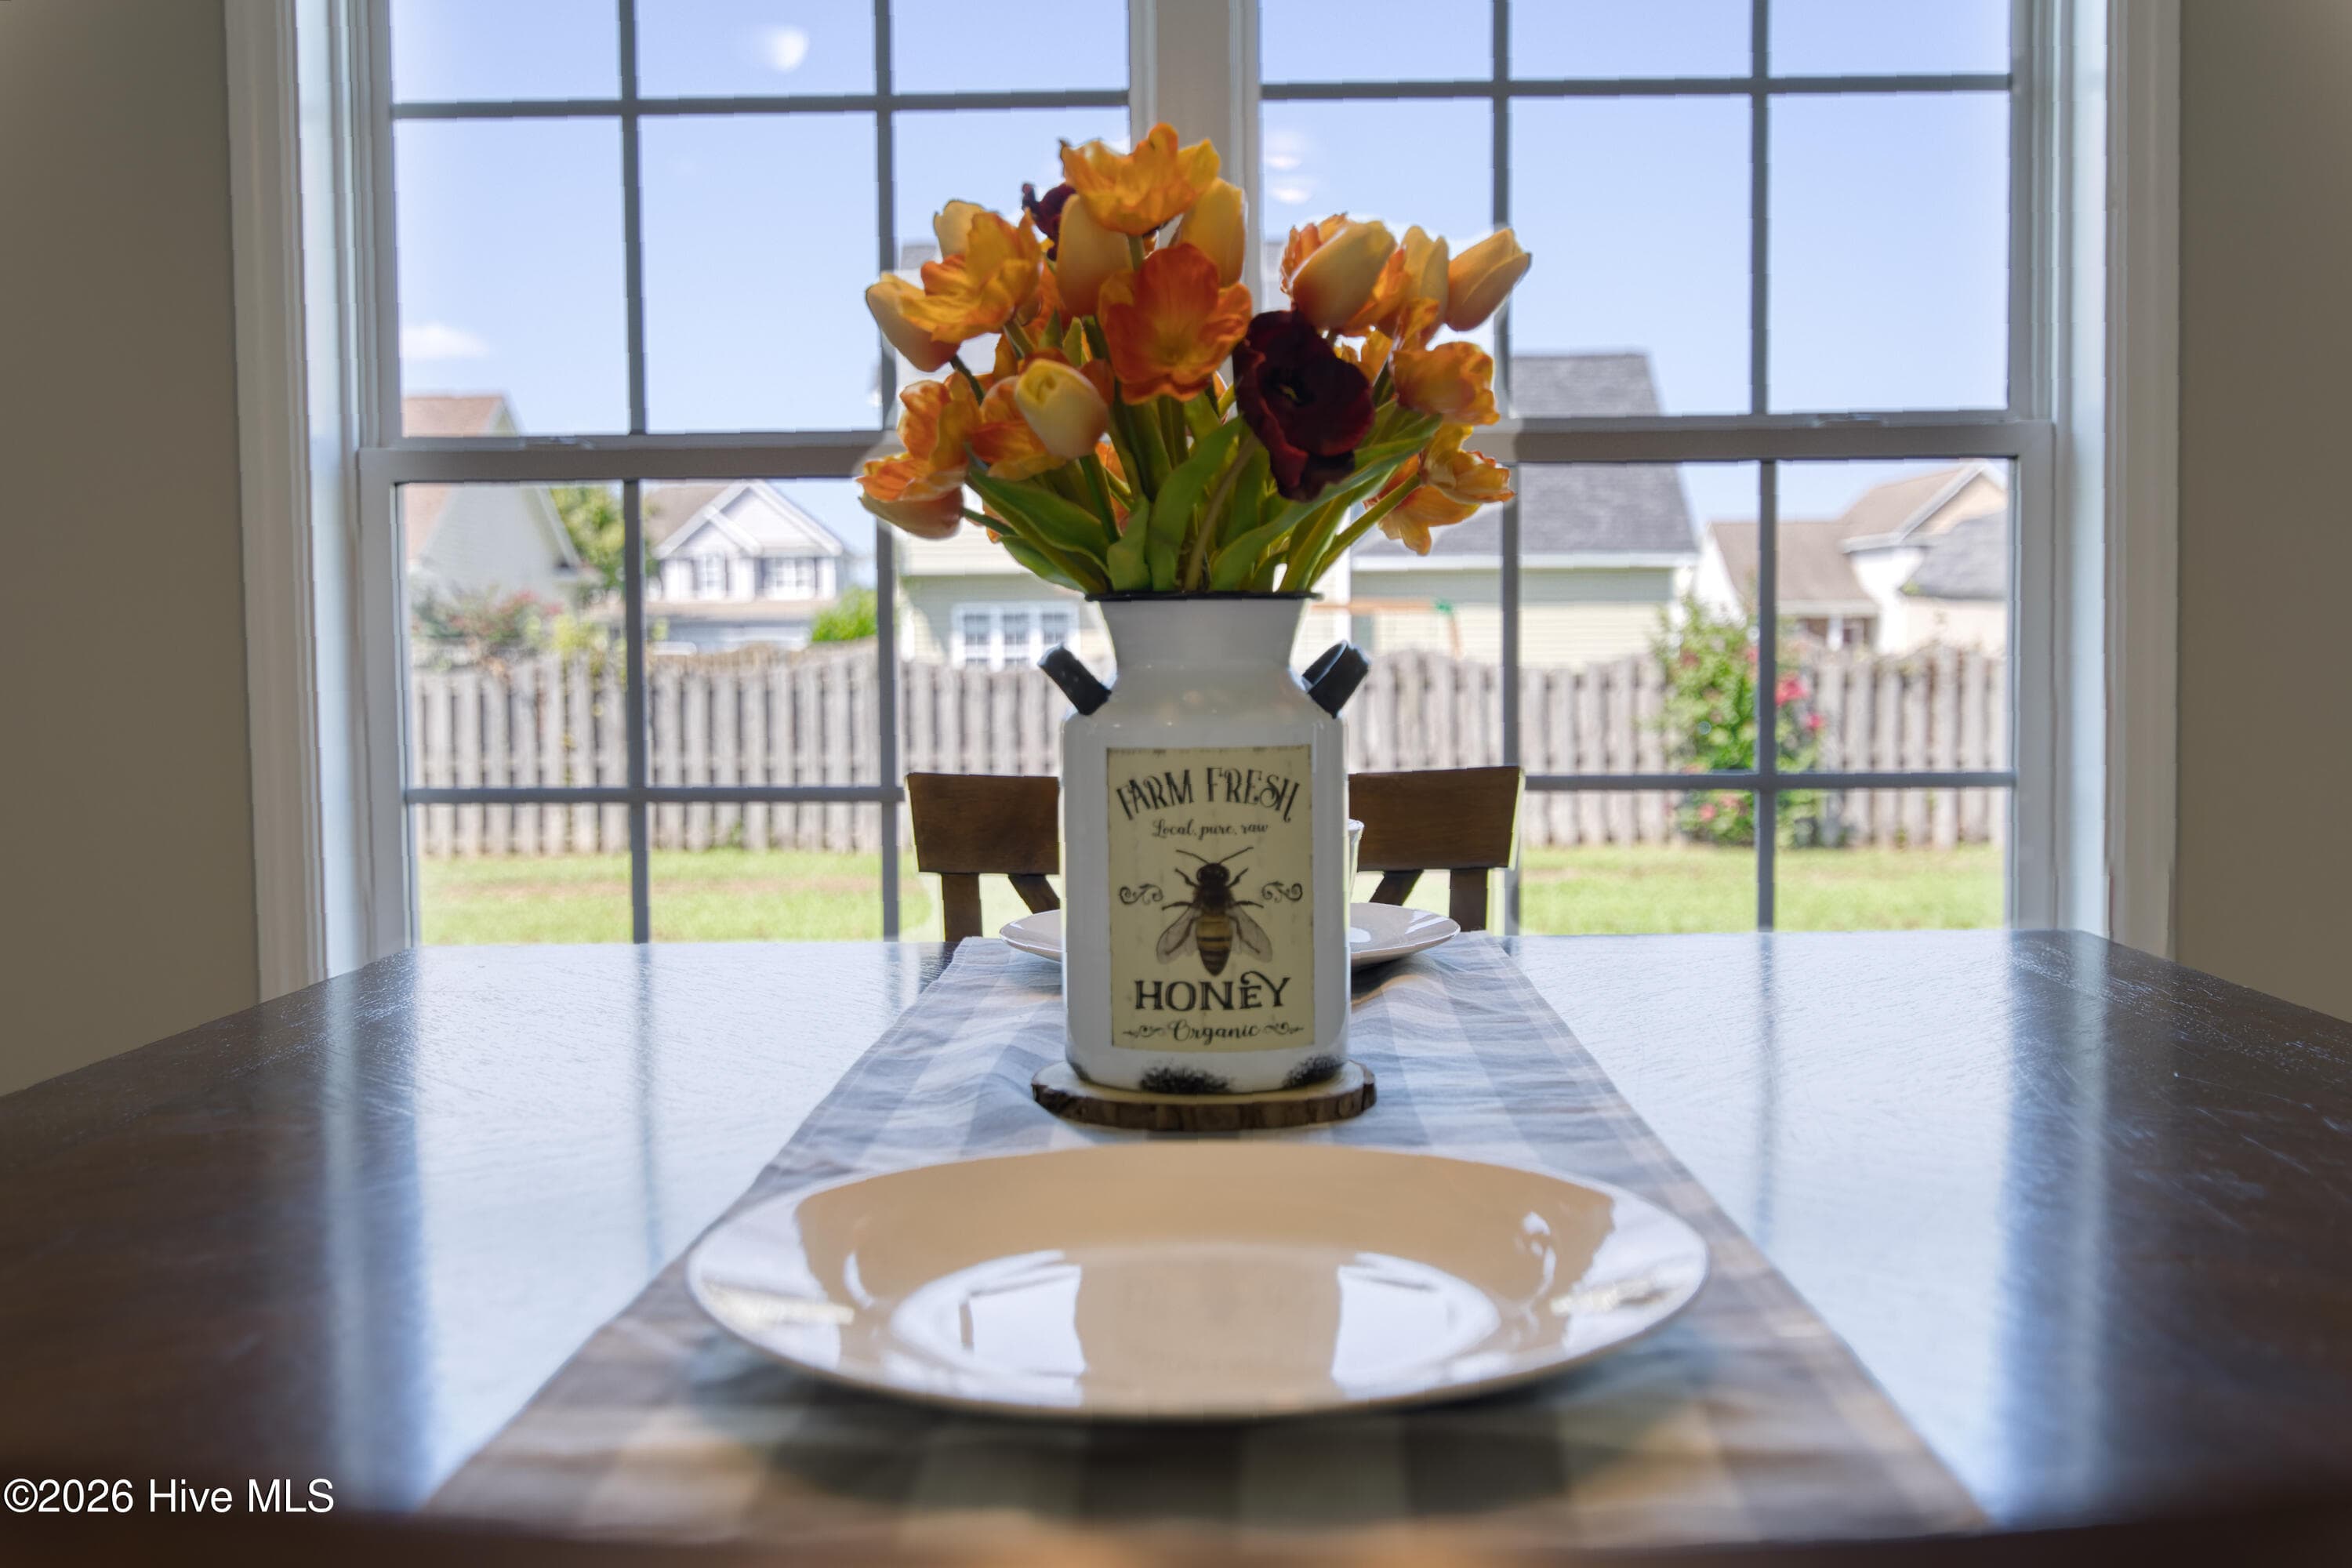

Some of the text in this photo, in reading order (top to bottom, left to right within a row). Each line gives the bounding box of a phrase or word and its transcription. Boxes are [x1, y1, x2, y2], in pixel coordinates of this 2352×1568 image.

[1116, 767, 1300, 822] FARM FRESH
[1241, 823, 1269, 835] raw
[1134, 971, 1290, 1011] HONEY
[1171, 1020, 1258, 1045] Organic
